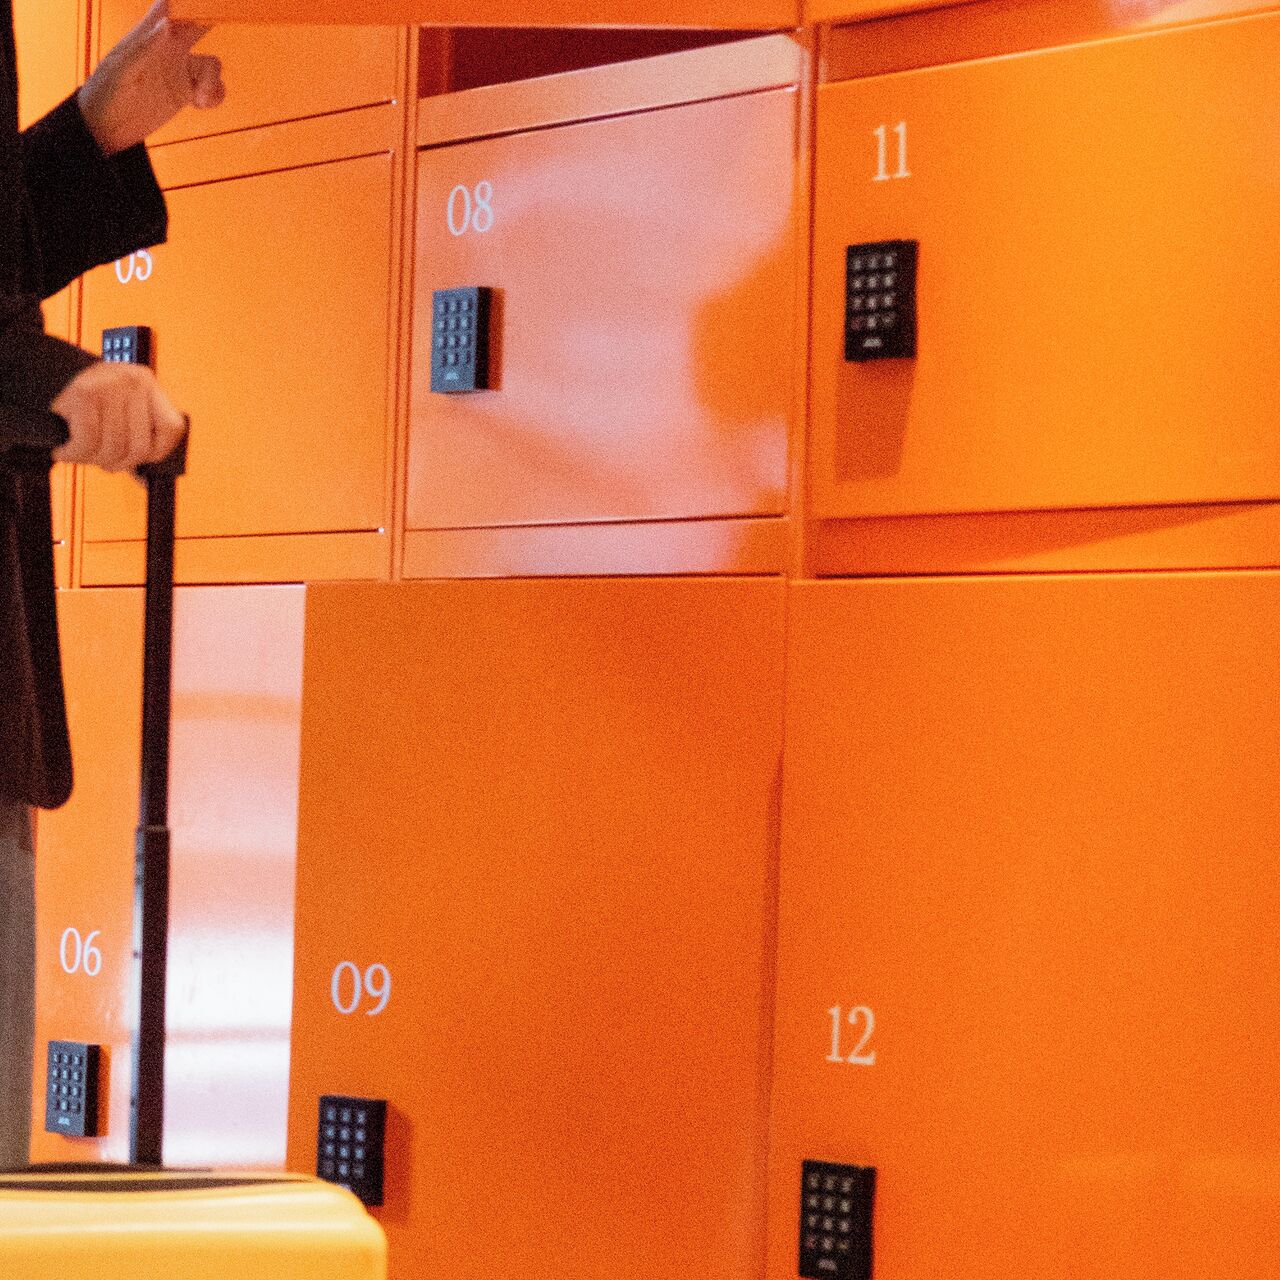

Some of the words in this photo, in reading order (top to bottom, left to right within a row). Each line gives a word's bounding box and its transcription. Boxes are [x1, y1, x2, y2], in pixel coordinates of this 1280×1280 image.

[873, 120, 911, 182] 11
[446, 180, 494, 237] 08
[59, 927, 102, 976] 06
[330, 960, 392, 1016] 09
[826, 1004, 876, 1066] 12
